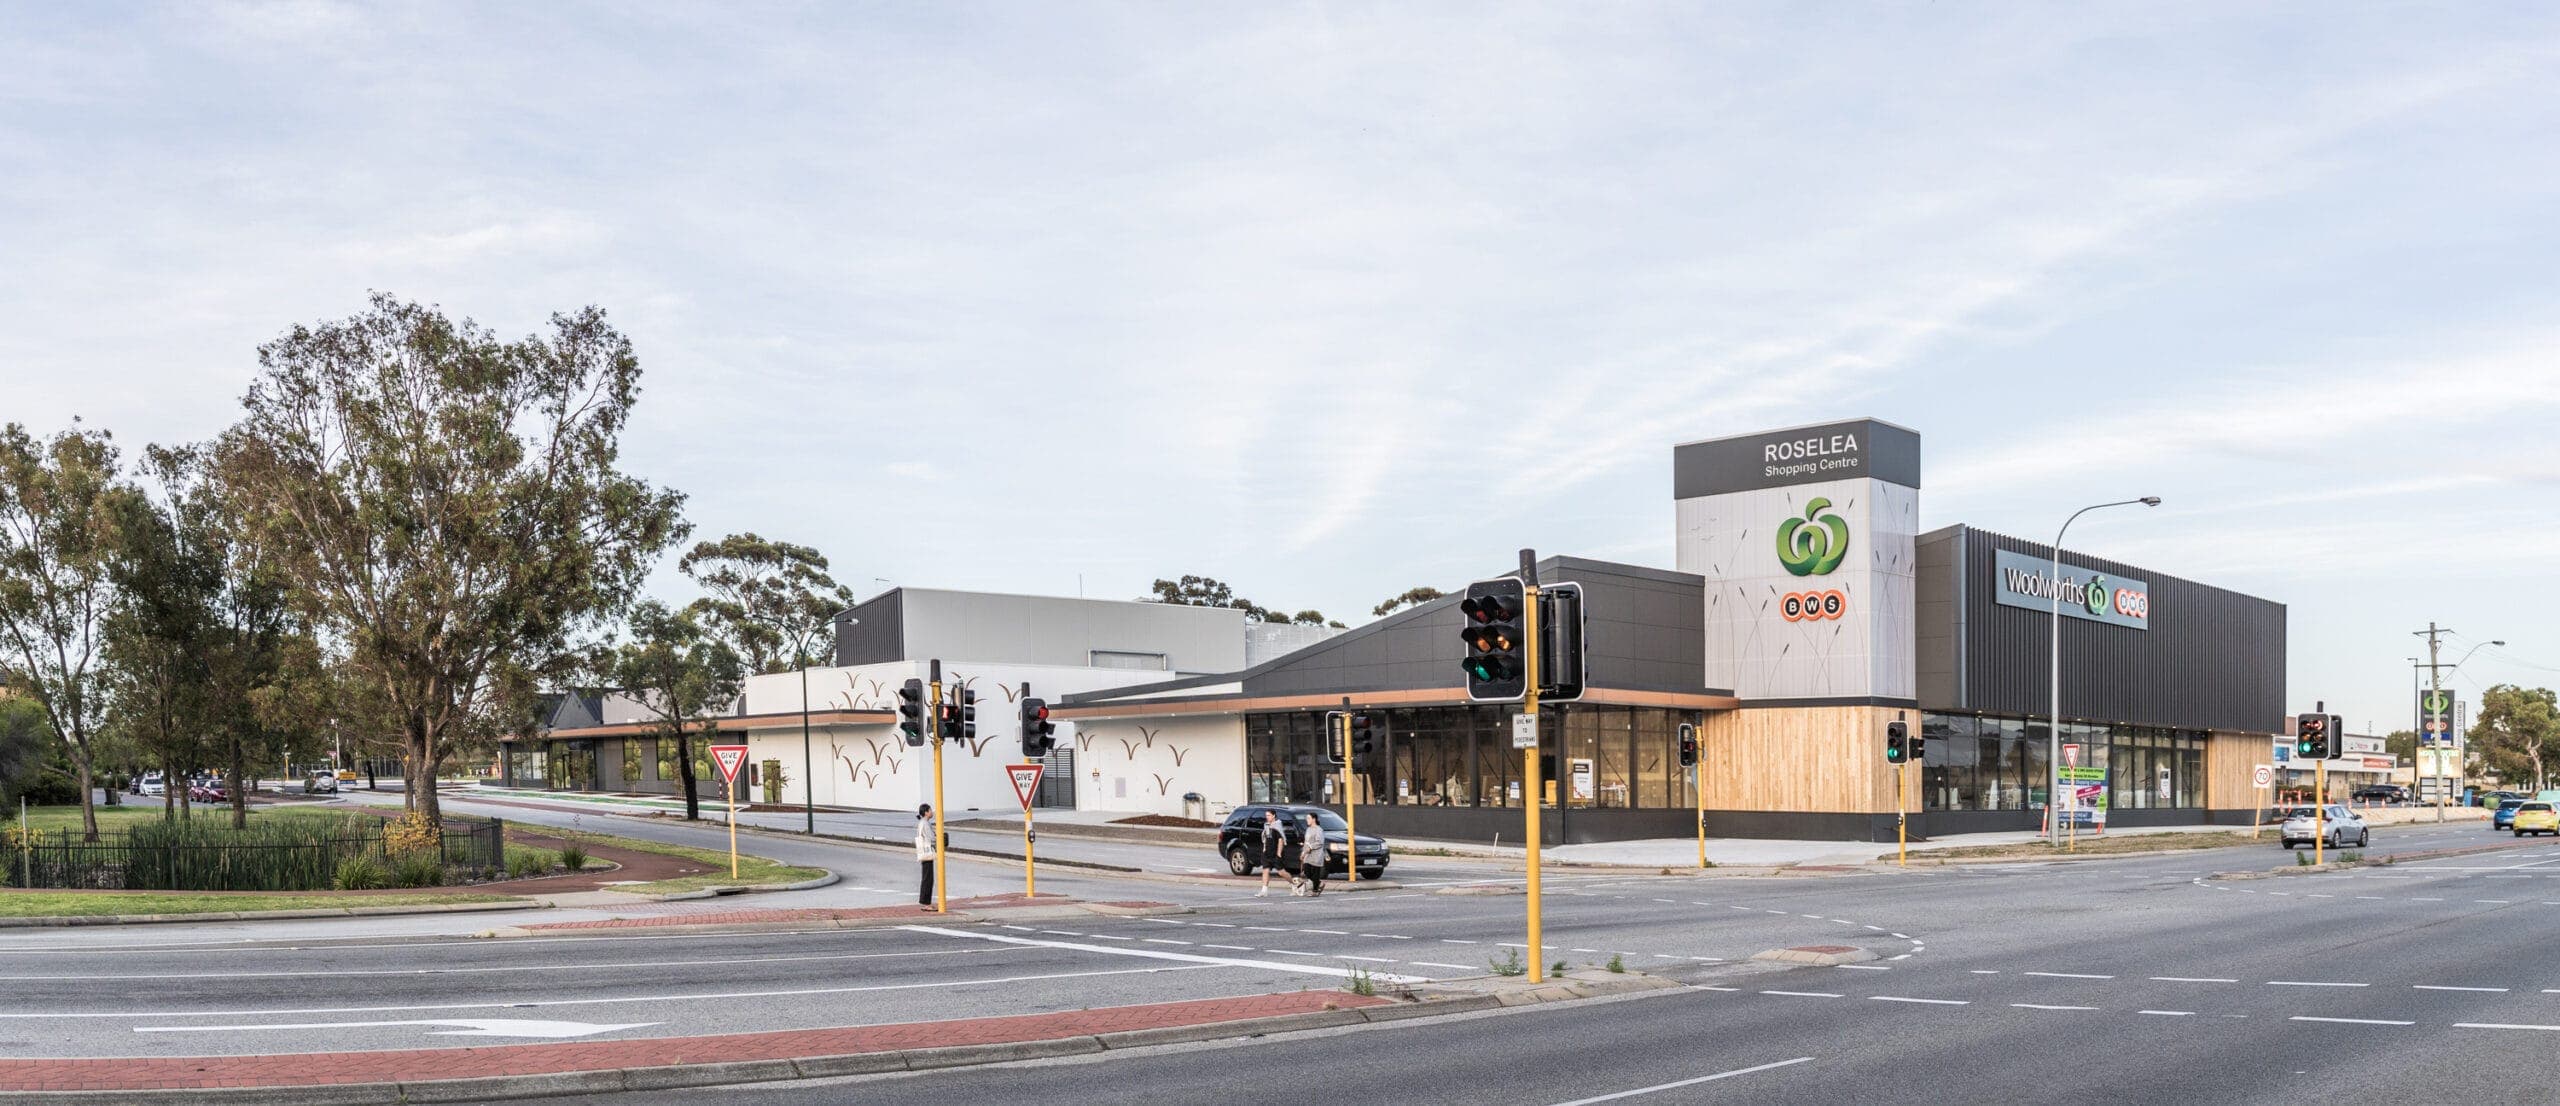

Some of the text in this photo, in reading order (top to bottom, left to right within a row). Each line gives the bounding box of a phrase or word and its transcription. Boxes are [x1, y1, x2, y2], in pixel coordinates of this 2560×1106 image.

[1764, 433, 1858, 462] ROSELEA
[1765, 457, 1858, 477] Shopping Centre
[2007, 567, 2085, 606] Woolworths
[720, 751, 738, 760] GIVE
[1015, 772, 1033, 781] GIVE
[2258, 772, 2269, 781] 70
